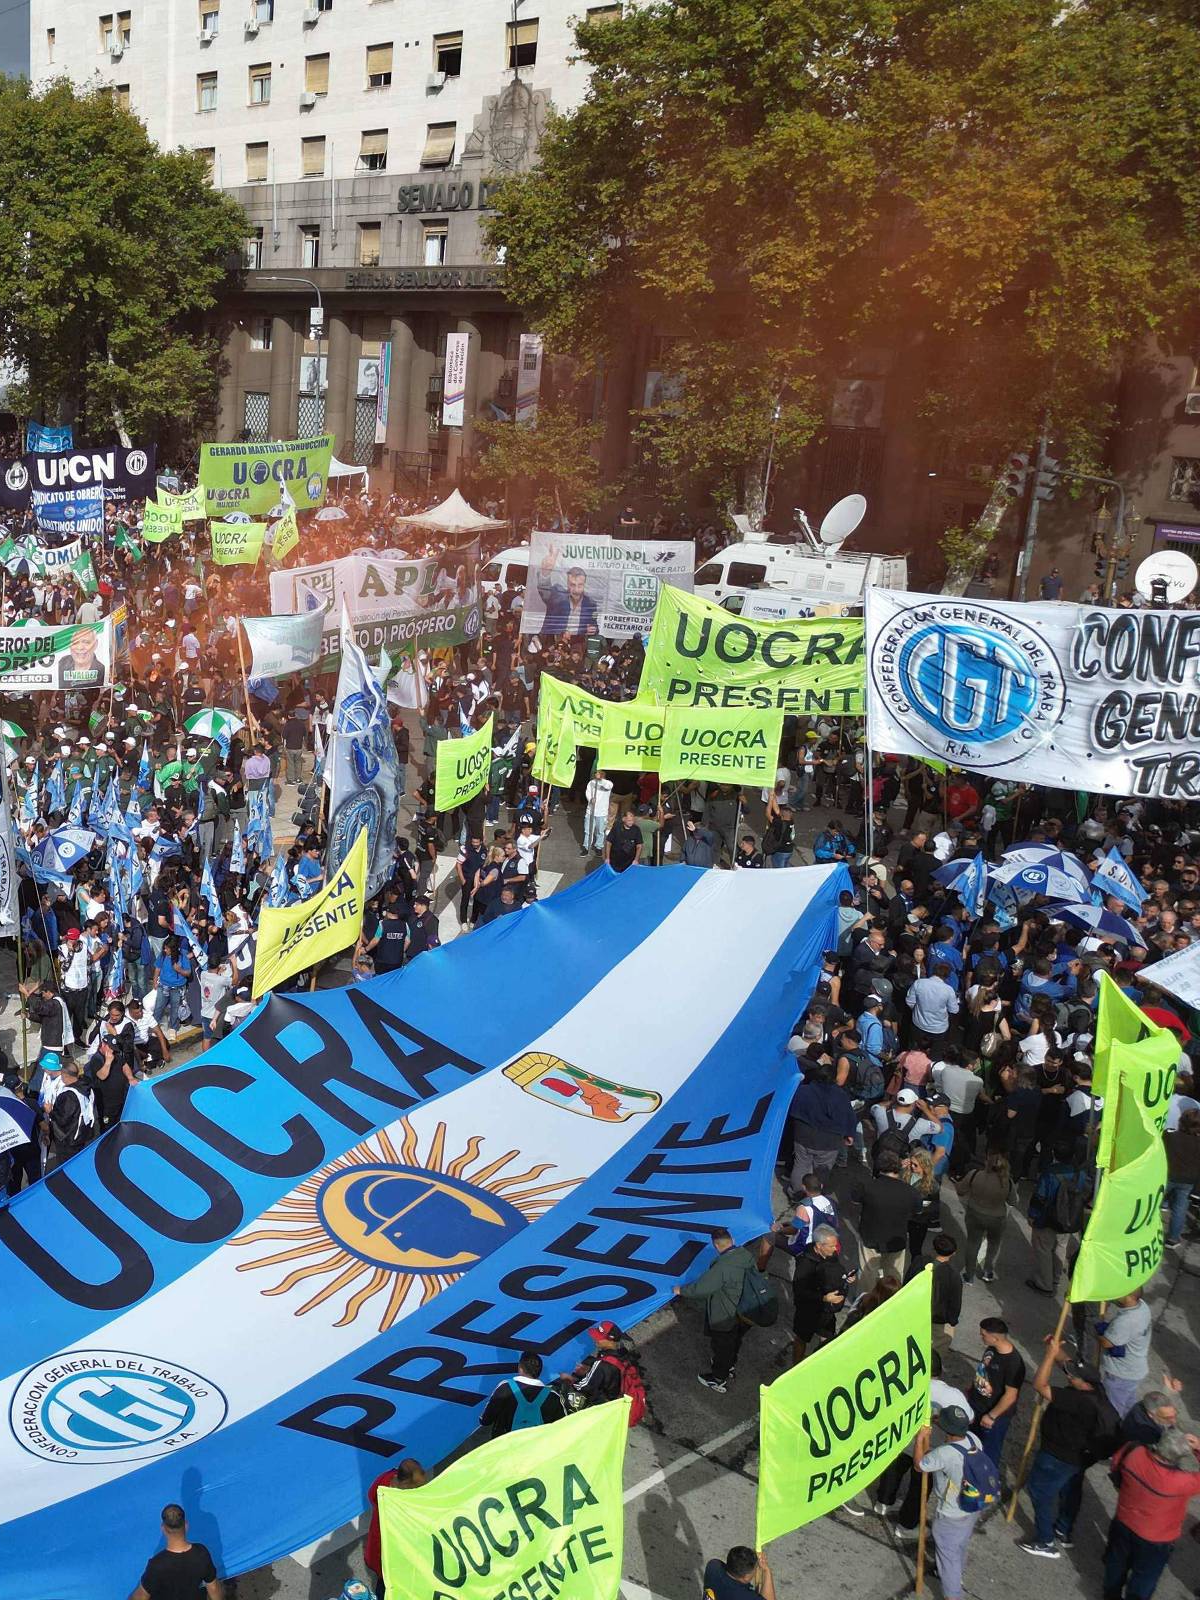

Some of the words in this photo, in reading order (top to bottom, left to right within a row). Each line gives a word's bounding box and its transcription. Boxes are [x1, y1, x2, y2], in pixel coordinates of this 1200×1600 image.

[398, 182, 473, 212] SENADO
[209, 445, 247, 457] GERARDO
[247, 443, 284, 455] MARTINEZ
[37, 452, 115, 486] UPCN
[65, 490, 75, 500] DE
[562, 545, 622, 560] JUVENTUD
[625, 551, 650, 565] APL
[358, 562, 439, 598] APL
[626, 577, 655, 589] APL
[34, 634, 56, 652] DEL
[374, 627, 387, 646] DI
[390, 614, 456, 642] PRÓSPERO
[939, 607, 1021, 641] GENERAL
[1022, 639, 1046, 668] DEL
[0, 674, 50, 684] CASEROS
[667, 678, 862, 712] PRESENT
[1090, 690, 1200, 753] GEN
[681, 728, 768, 749] UOCRA
[679, 751, 767, 769] PRESENTE
[279, 1091, 777, 1458] PRESENTE
[44, 1358, 112, 1384] GENERAL
[116, 1358, 146, 1373] DEL
[151, 1366, 209, 1399] TRABAJO
[801, 1333, 928, 1459] UOCRA
[22, 1381, 78, 1459] CONFEDERACION
[807, 1391, 926, 1504] PRESENTE
[431, 1462, 599, 1589] UOCRA
